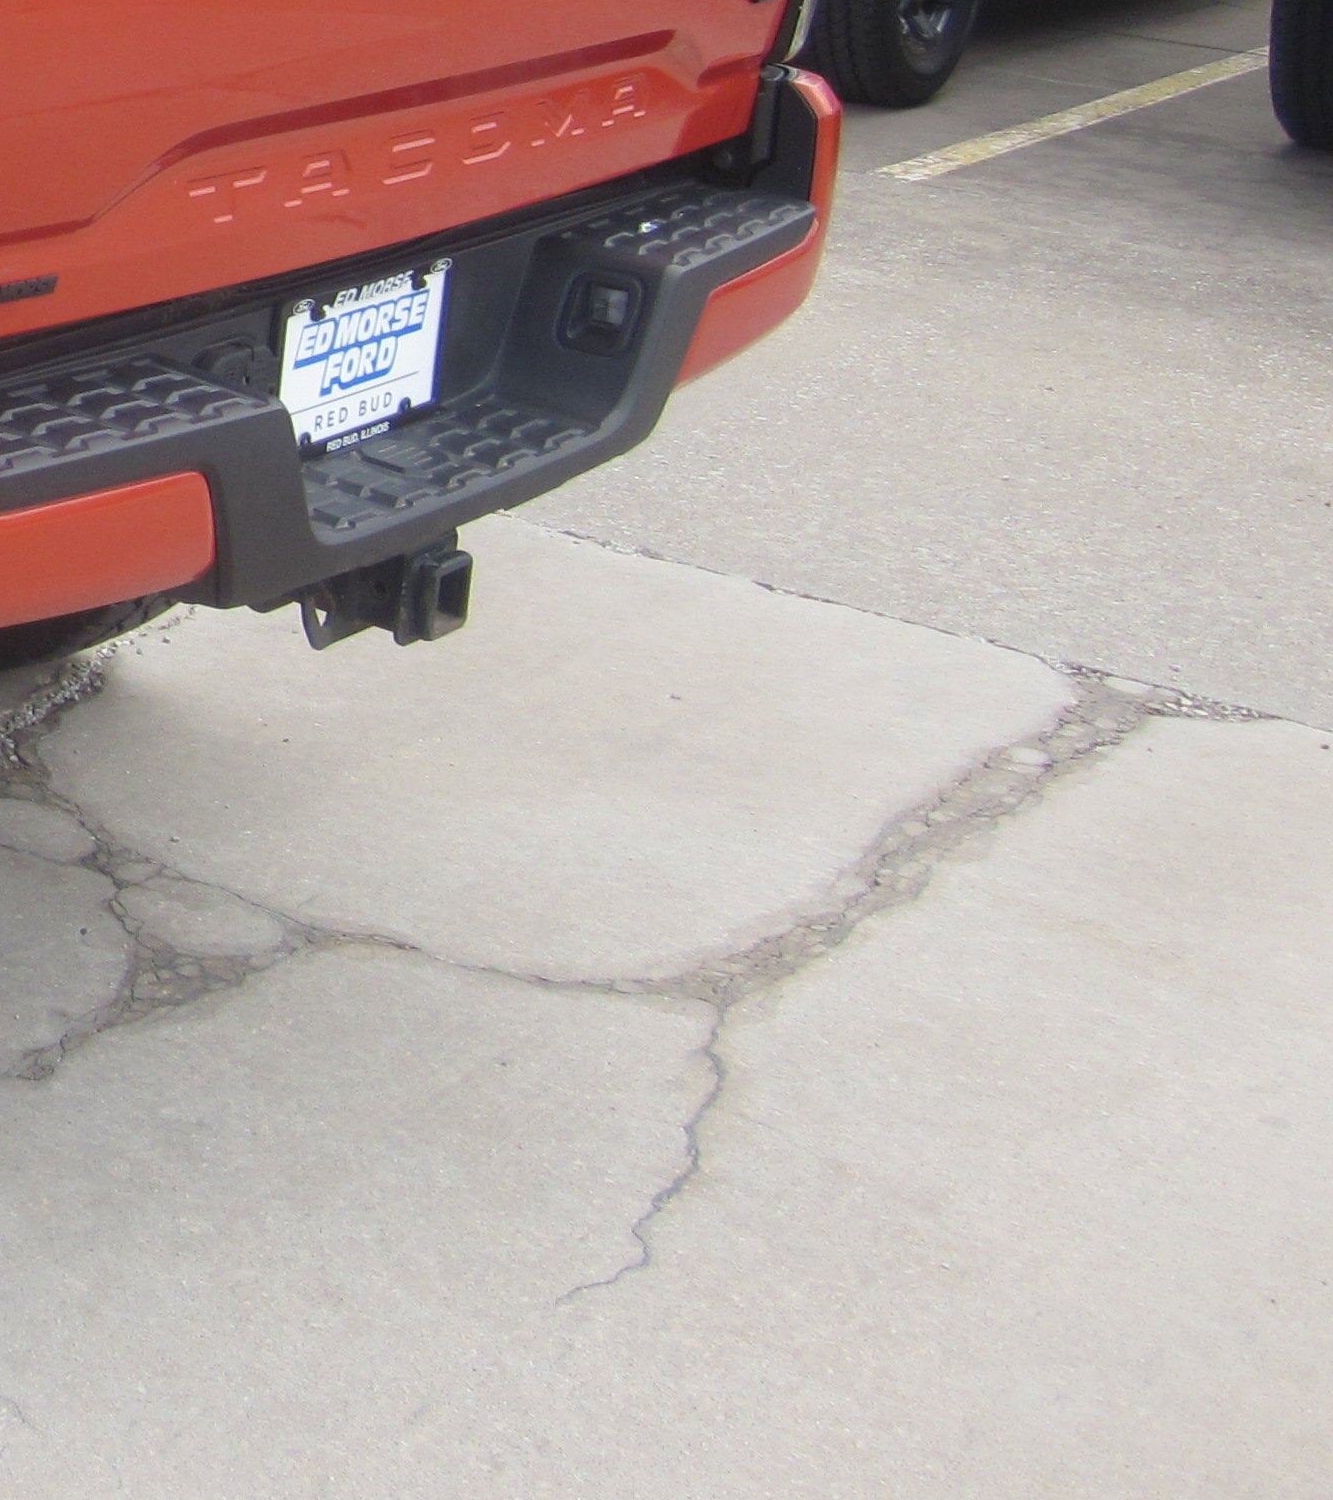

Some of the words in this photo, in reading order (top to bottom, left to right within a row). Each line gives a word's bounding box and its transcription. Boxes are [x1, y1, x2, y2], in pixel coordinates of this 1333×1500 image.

[187, 74, 647, 223] TACOMA
[334, 288, 359, 308] ED
[359, 270, 414, 301] MORSE
[295, 319, 336, 367] ED
[334, 290, 429, 351] MORSE
[320, 337, 398, 395] FORD
[314, 406, 349, 432] RED
[358, 392, 393, 417] BUD
